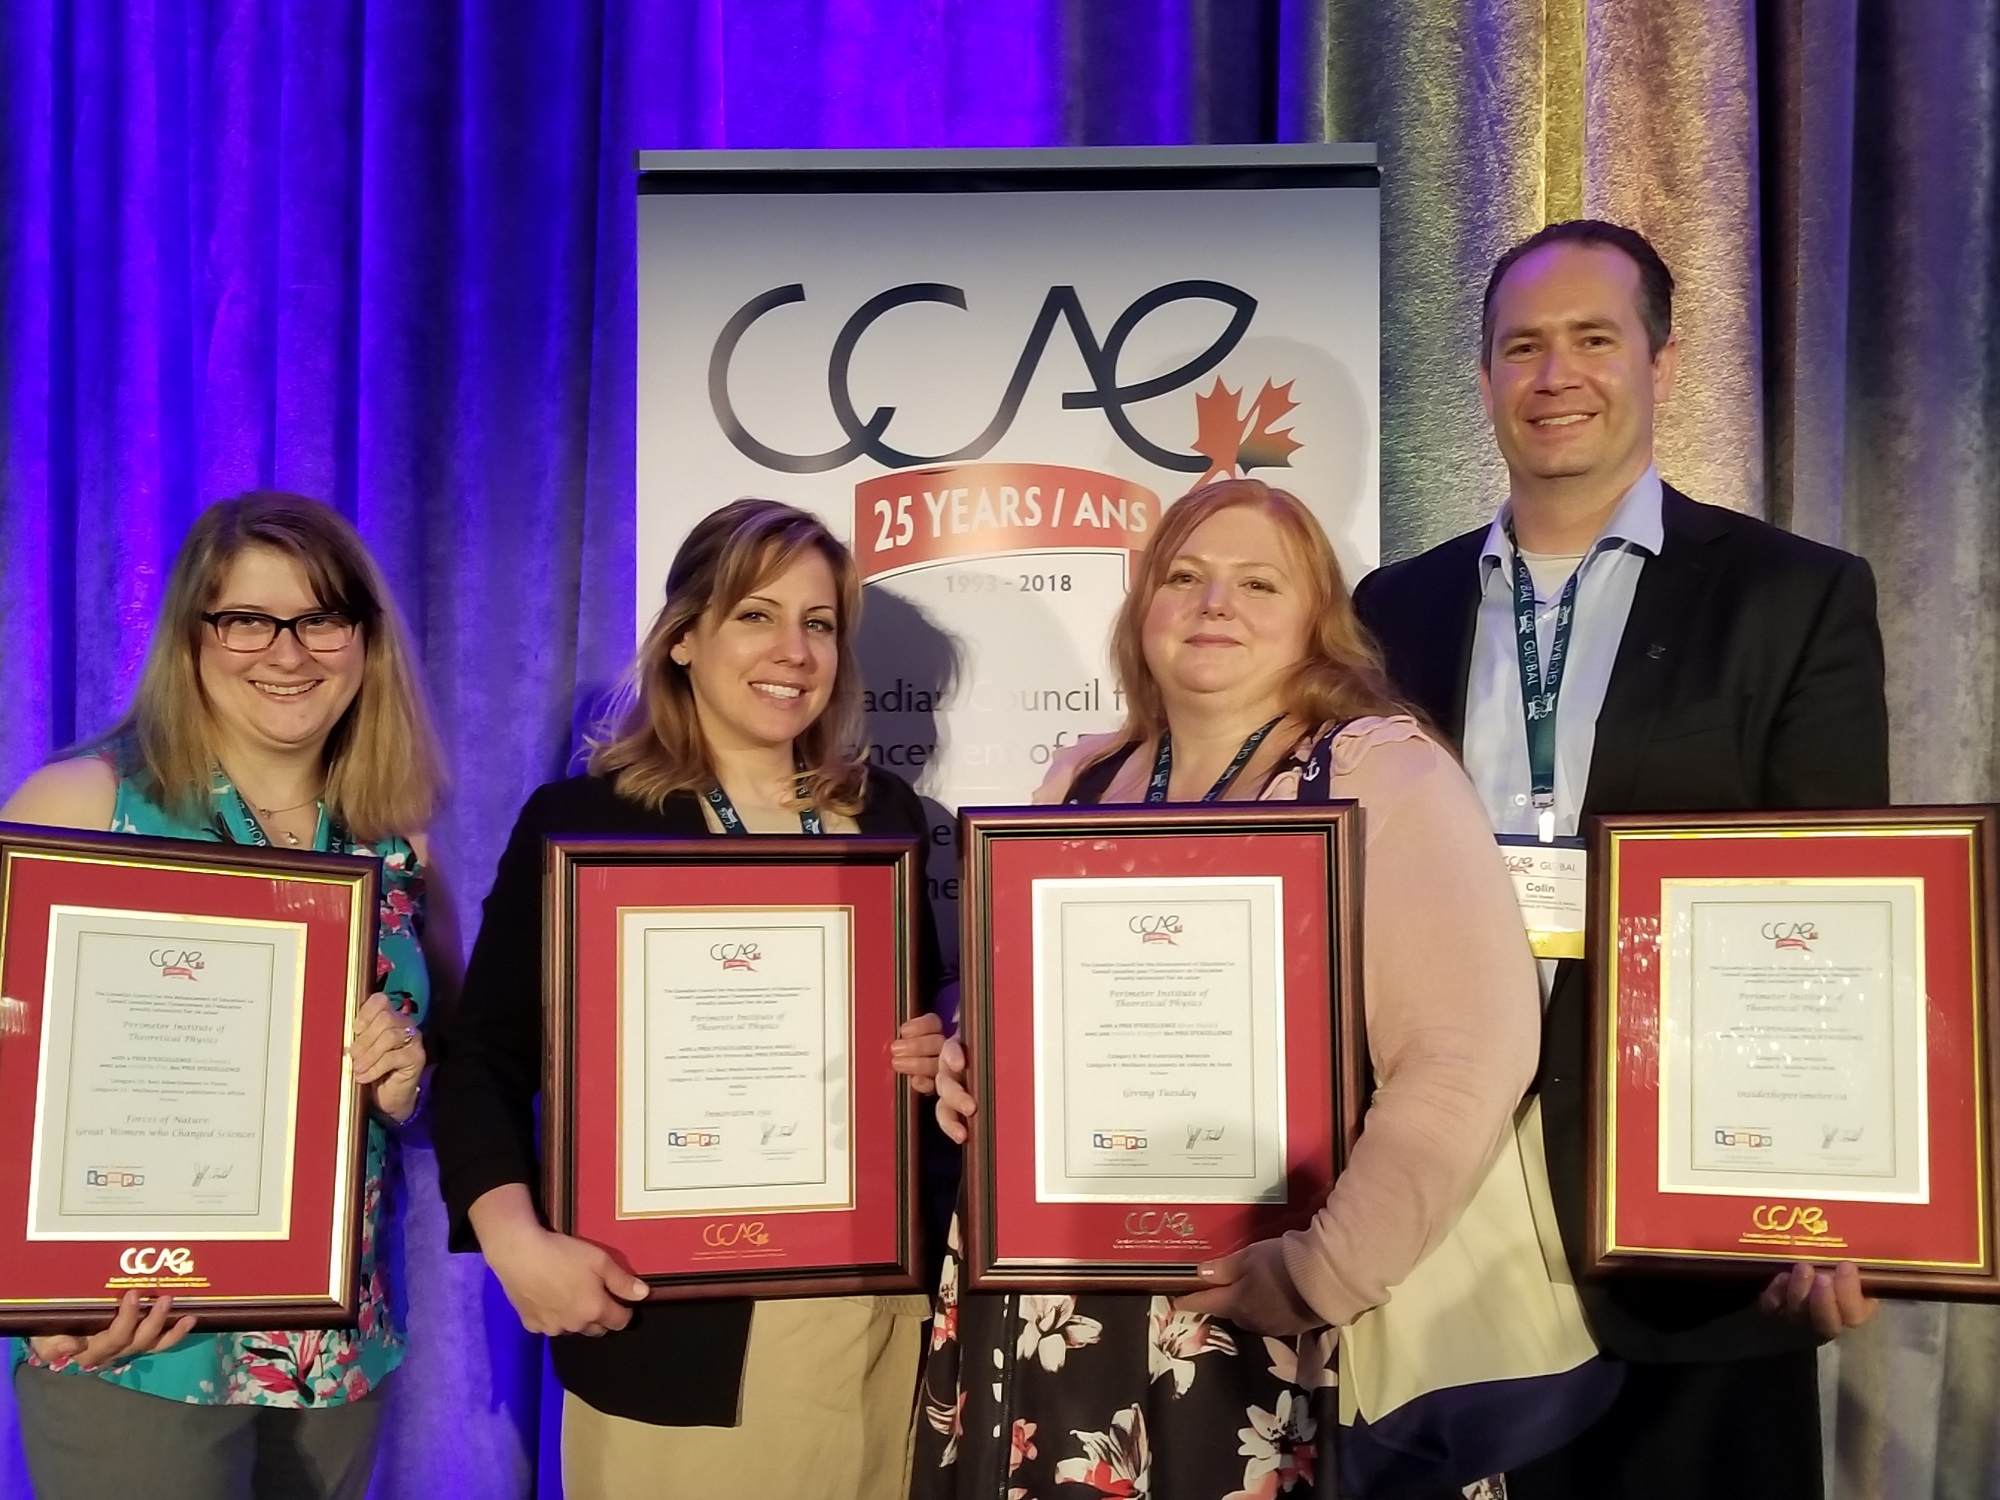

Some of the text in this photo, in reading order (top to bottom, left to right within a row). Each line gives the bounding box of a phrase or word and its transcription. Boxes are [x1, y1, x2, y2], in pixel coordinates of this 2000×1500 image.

[873, 486, 1148, 552] 25 YEARS / ANS
[946, 574, 998, 593] 1993
[1019, 574, 1072, 593] 2018
[970, 679, 1099, 712] Council
[1526, 882, 1555, 894] Colin
